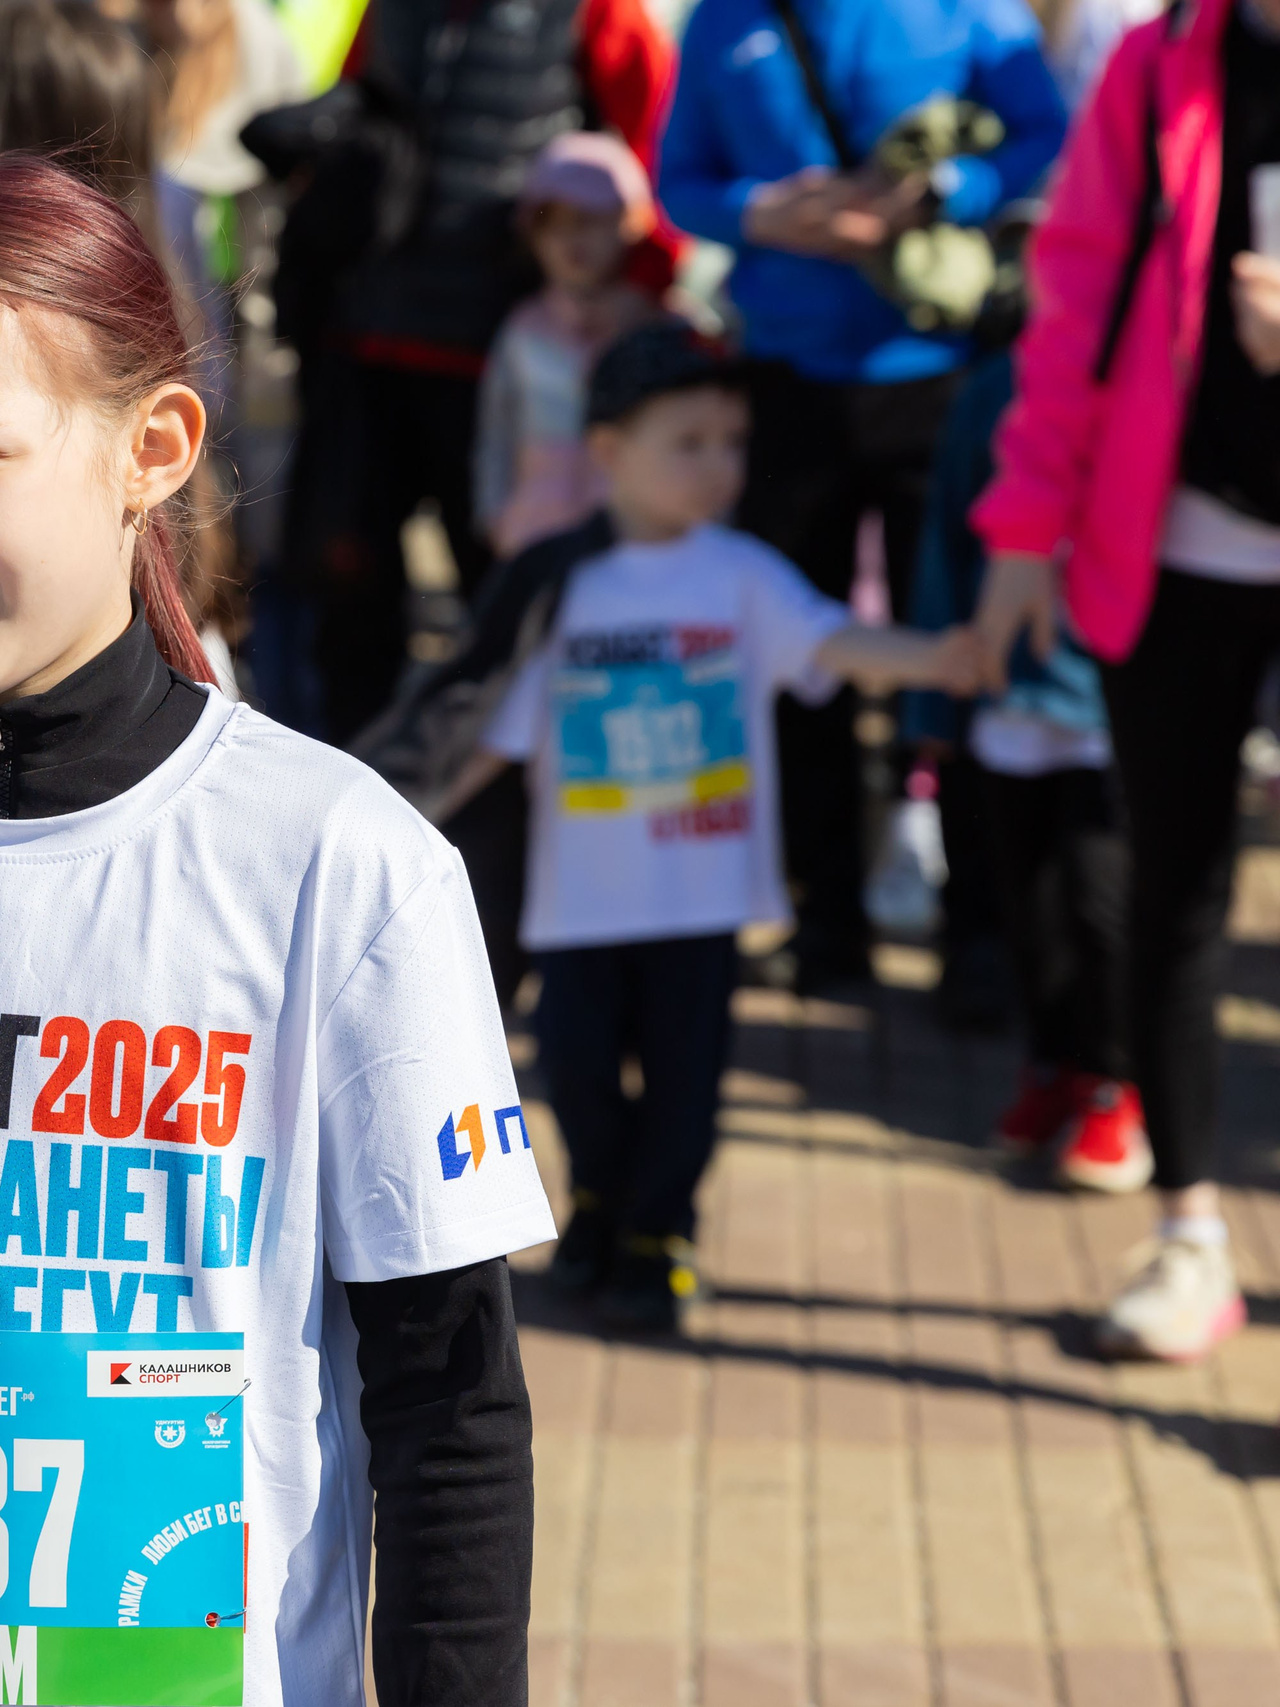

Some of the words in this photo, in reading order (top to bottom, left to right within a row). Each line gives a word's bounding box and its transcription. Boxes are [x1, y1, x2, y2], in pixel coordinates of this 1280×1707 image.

[139, 1363, 232, 1374] КАЛАШНИКОВ
[139, 1374, 181, 1384] СПОРТ
[118, 1569, 149, 1627] РАМКИ
[140, 1518, 189, 1566] ЛЮБИ
[183, 1506, 213, 1536] БЕГ
